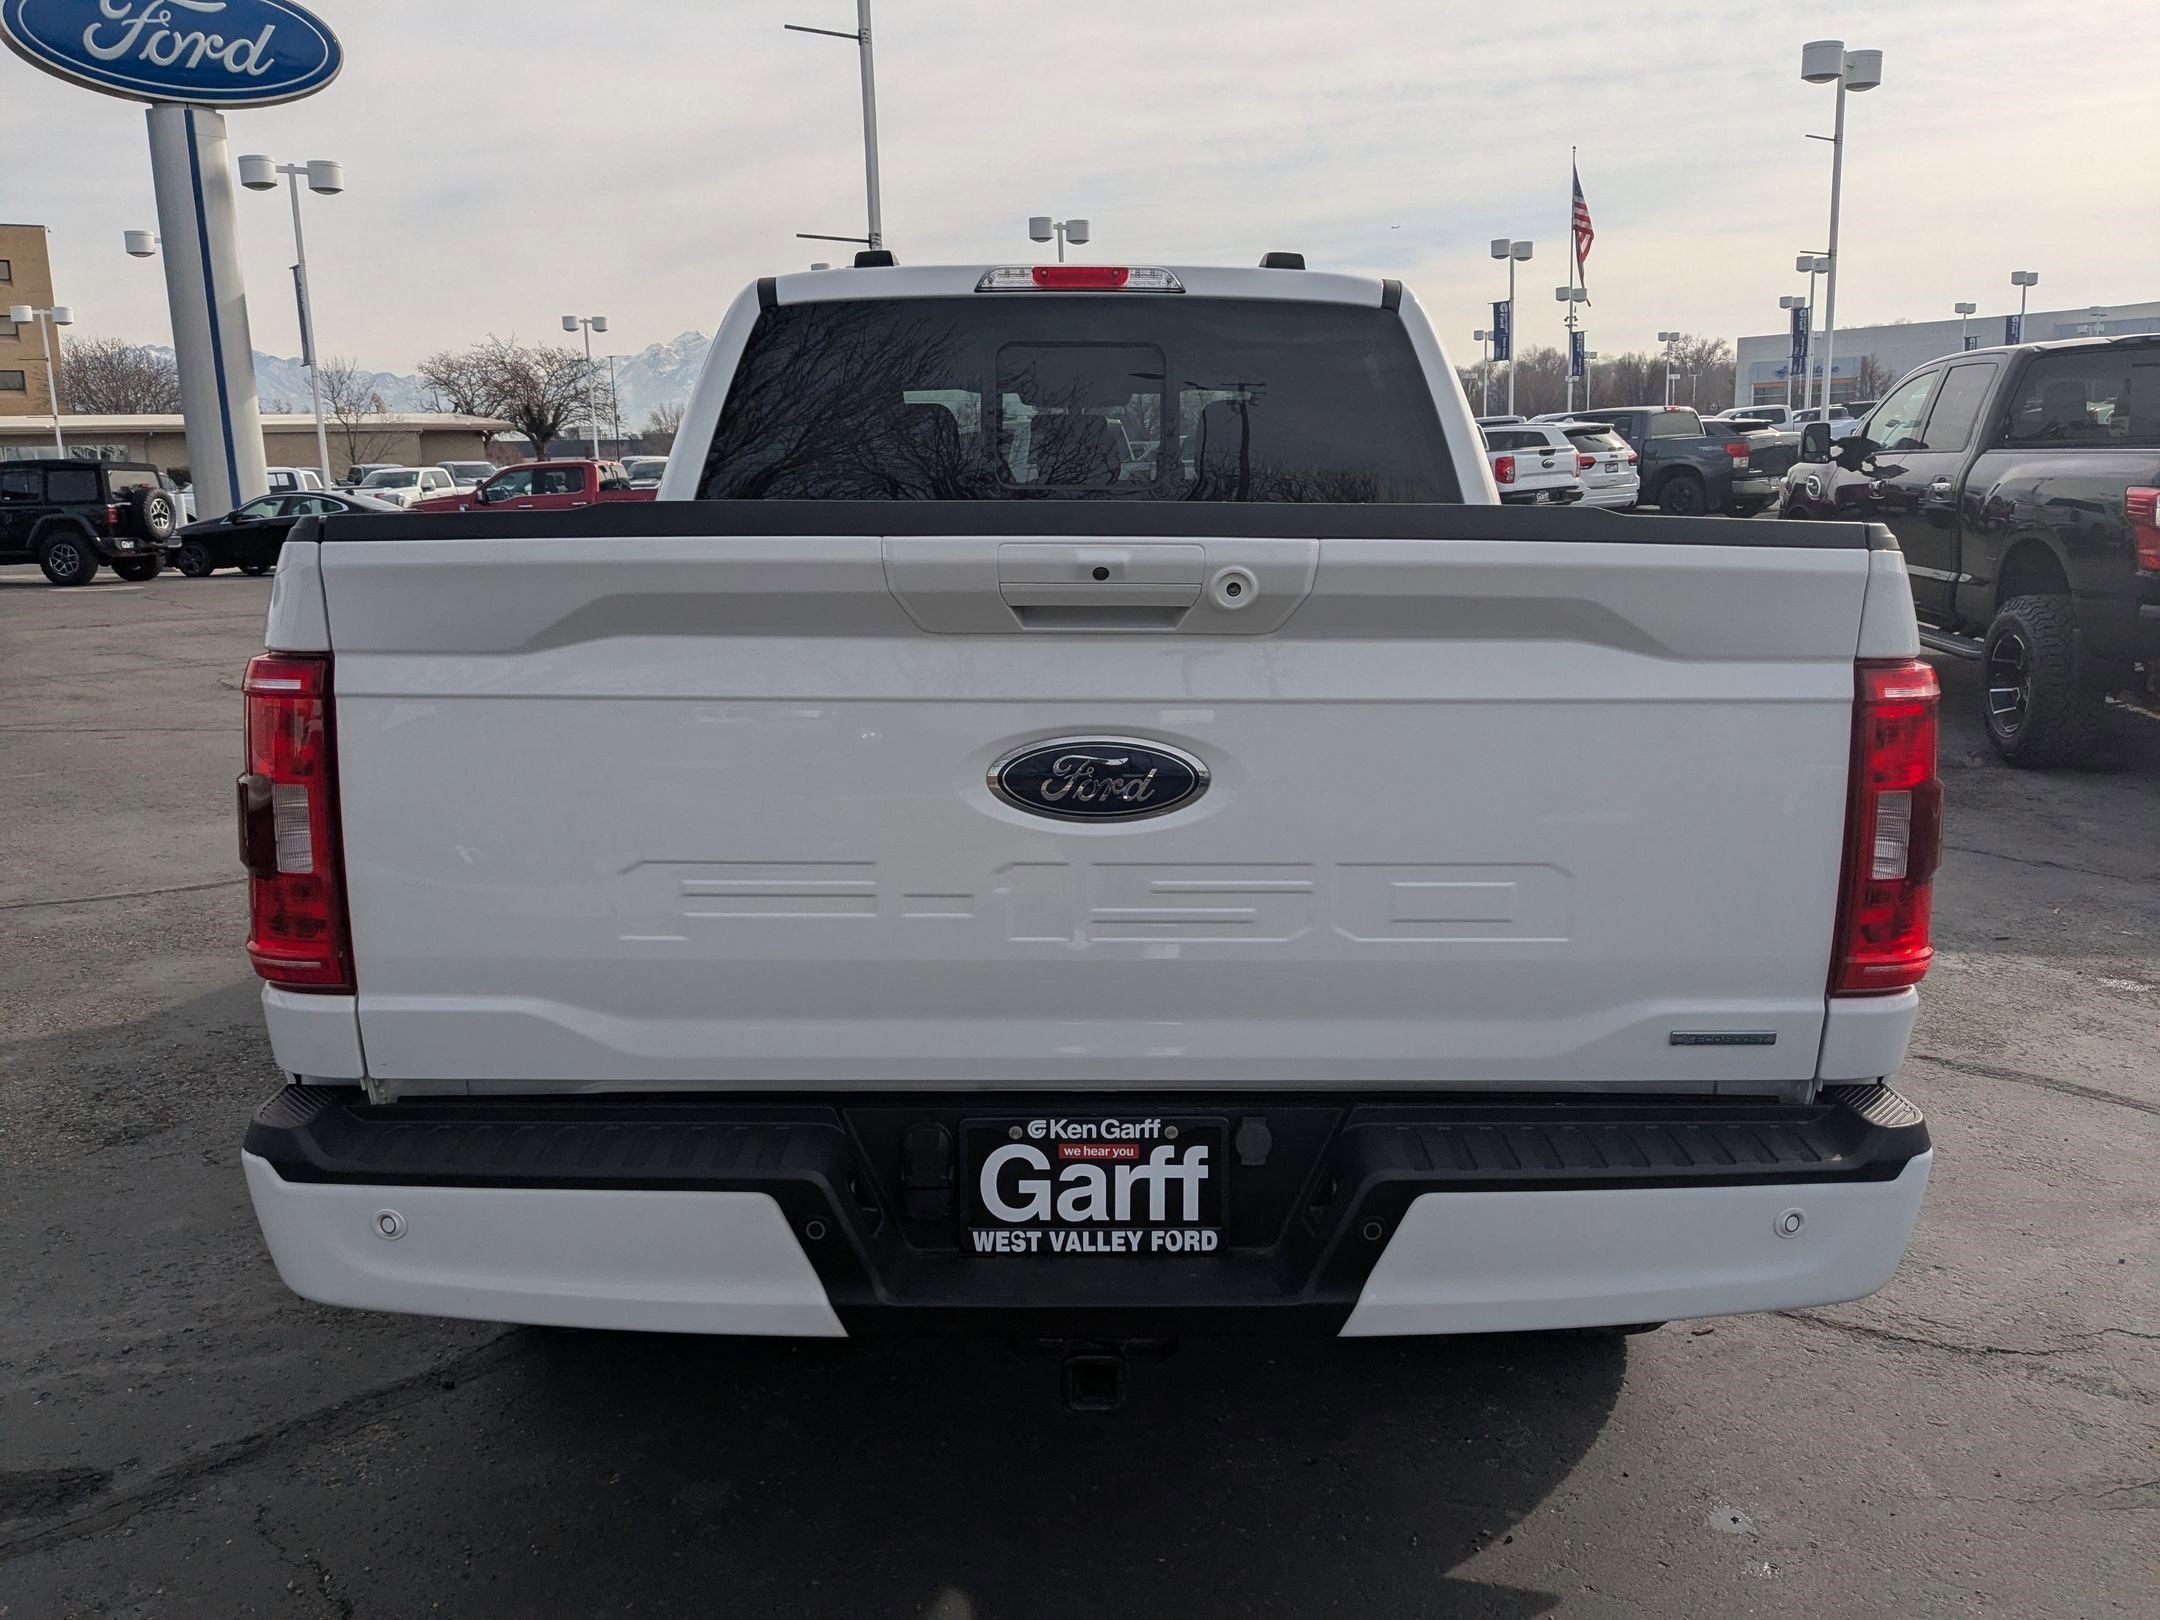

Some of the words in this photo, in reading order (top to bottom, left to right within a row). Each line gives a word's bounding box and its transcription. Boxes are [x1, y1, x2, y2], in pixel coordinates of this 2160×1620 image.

[83, 0, 276, 76] Ford
[1040, 754, 1156, 801] Ford
[1050, 1119, 1097, 1139] Ken
[1100, 1119, 1161, 1139] Garff
[1064, 1147, 1082, 1156] we
[1084, 1145, 1110, 1157] hear
[1112, 1146, 1134, 1158] you
[980, 1143, 1209, 1222] Garff
[973, 1231, 1042, 1252] WEST
[1049, 1231, 1143, 1252] VALLEY
[1151, 1230, 1218, 1252] FORD
